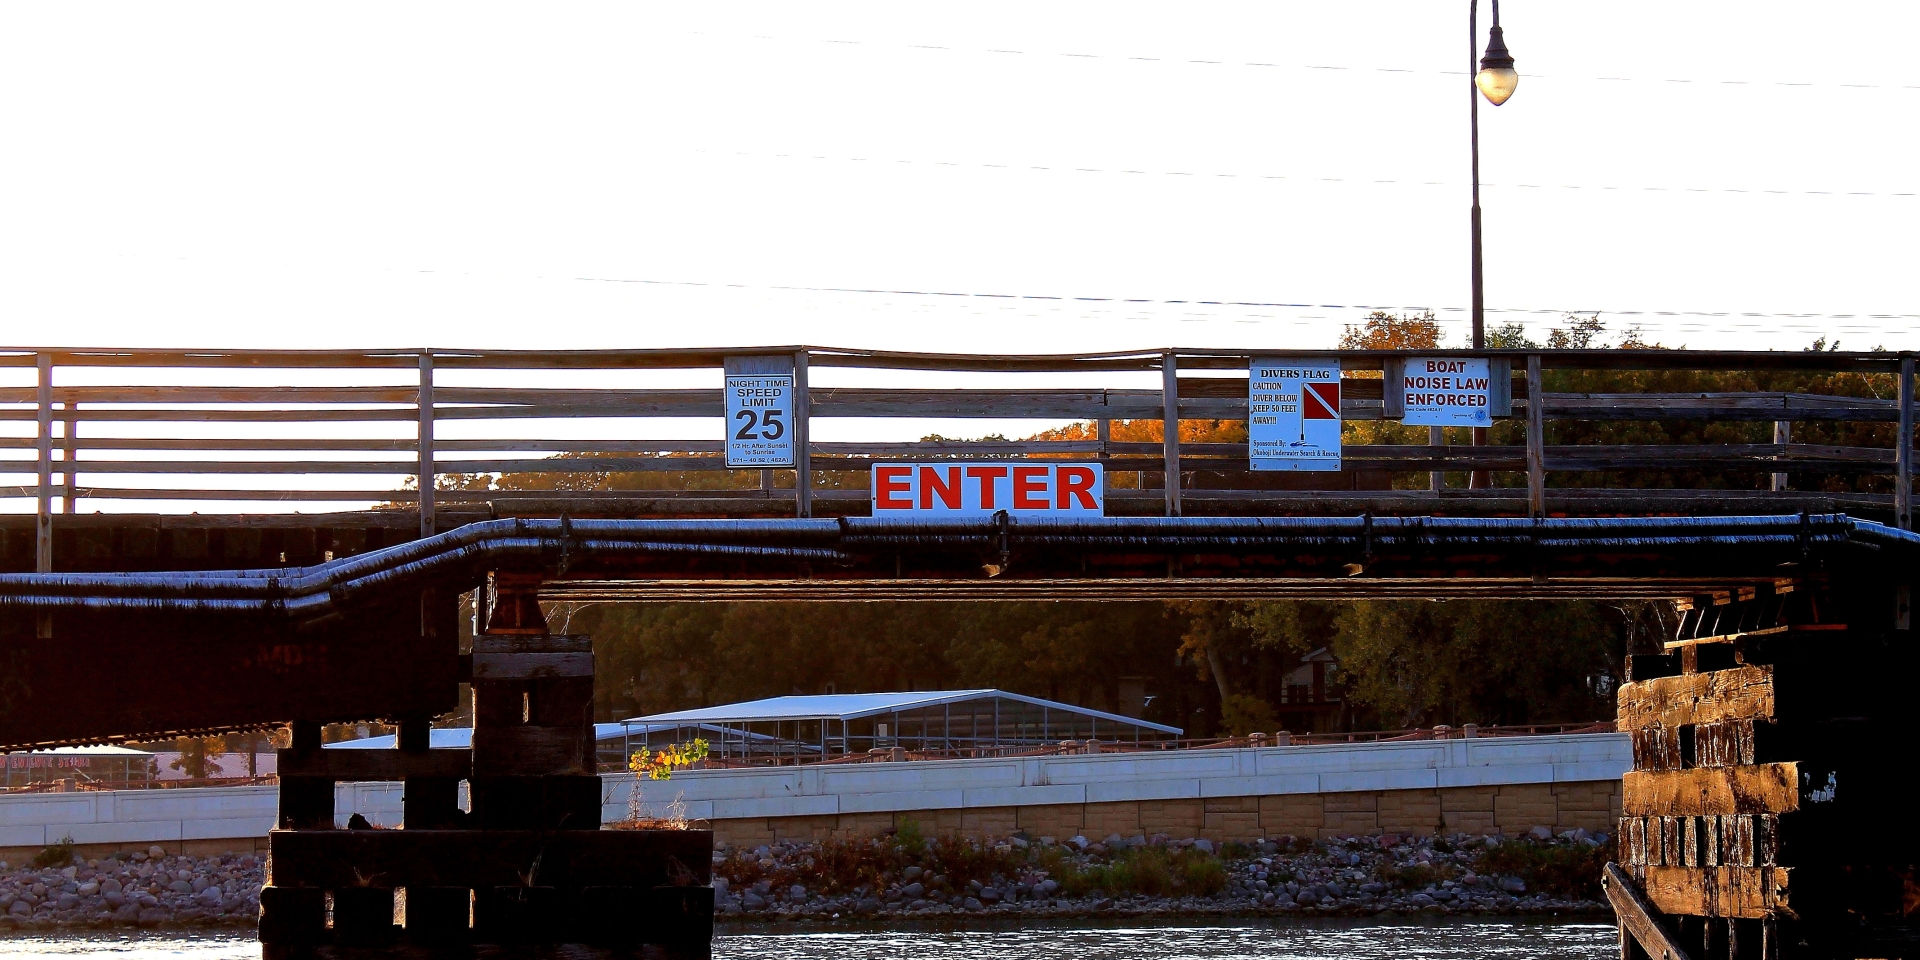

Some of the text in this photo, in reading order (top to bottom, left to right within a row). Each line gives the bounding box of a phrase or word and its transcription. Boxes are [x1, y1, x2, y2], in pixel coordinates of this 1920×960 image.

[1426, 360, 1467, 374] BOAT
[1261, 369, 1330, 379] DIVERS FLAG
[729, 380, 761, 388] NIGHT
[1252, 382, 1282, 391] CAUTION
[1404, 376, 1489, 391] NOISE LAW
[737, 388, 782, 398] SPEED
[741, 398, 776, 407] LIMIT
[1252, 394, 1298, 403] DIVER BELOW
[1406, 393, 1487, 407] ENFORCED
[1252, 404, 1297, 413] KEEP 50 FEET
[735, 409, 784, 440] 25
[875, 466, 1099, 510] ENTER
